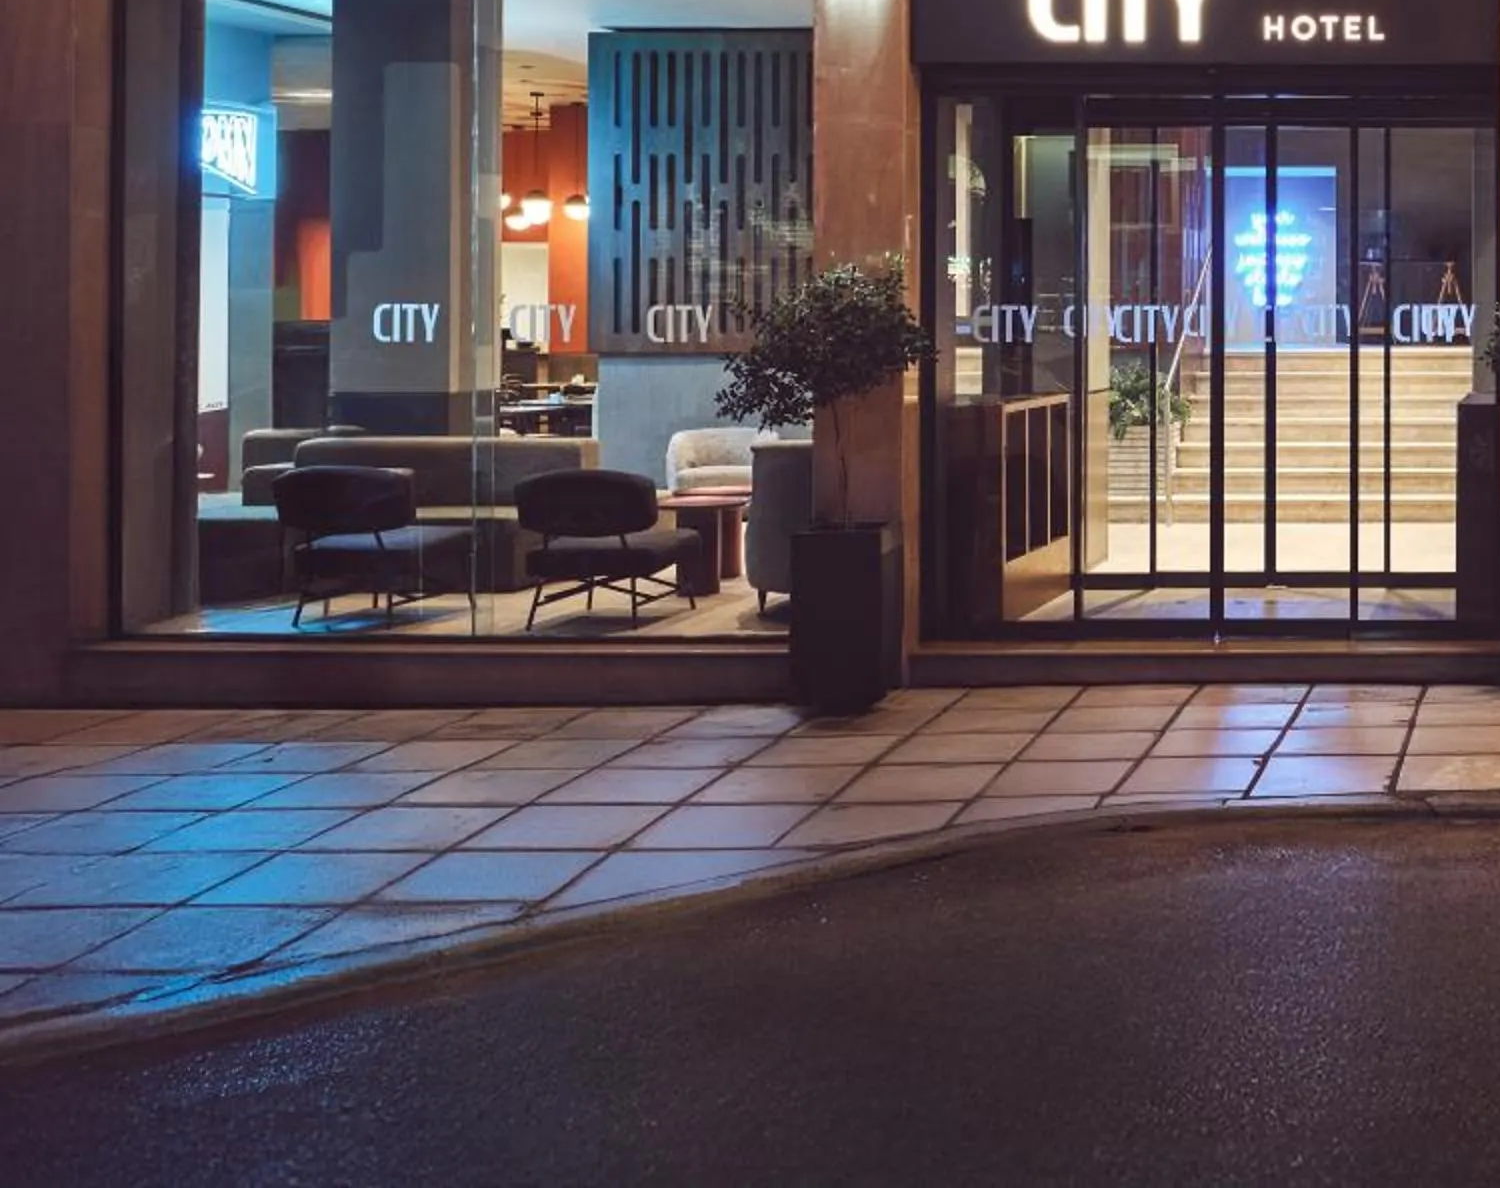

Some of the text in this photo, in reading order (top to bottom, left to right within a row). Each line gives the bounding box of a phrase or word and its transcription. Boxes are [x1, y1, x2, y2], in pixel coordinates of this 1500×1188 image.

[1263, 15, 1385, 41] HOTEL
[373, 303, 440, 343] CITY
[510, 304, 577, 343] CITY
[646, 304, 713, 343] CITY
[973, 304, 1038, 343] CITY
[1116, 304, 1179, 343] CITY
